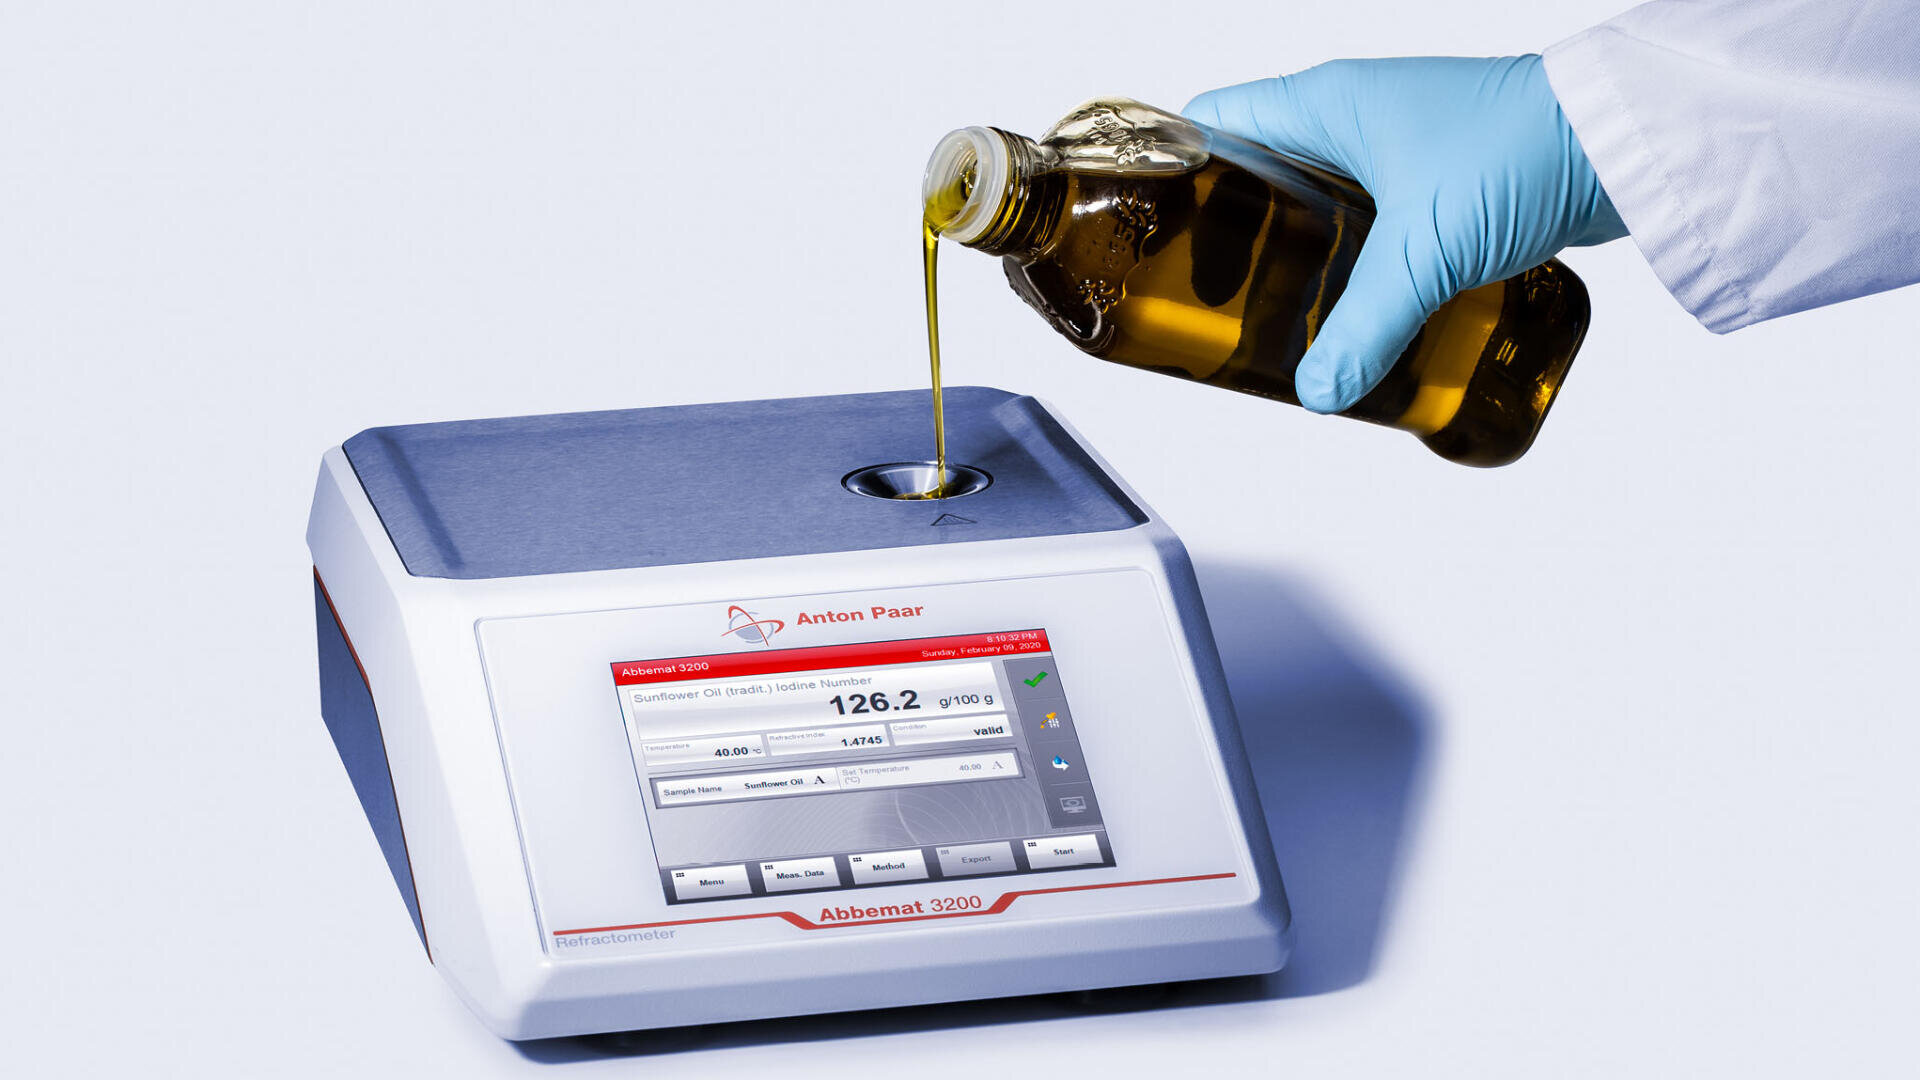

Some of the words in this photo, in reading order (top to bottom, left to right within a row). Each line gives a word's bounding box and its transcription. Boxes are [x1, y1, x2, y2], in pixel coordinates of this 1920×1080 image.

[797, 610, 863, 625] Anton
[871, 605, 924, 618] Paar
[1021, 632, 1038, 640] PM
[921, 649, 959, 658] Sunday,
[960, 645, 1001, 655] February
[1003, 644, 1018, 652] 09,
[1019, 641, 1041, 650] 2020
[621, 664, 676, 676] Abbemat
[678, 662, 710, 672] 3200
[633, 690, 700, 703] Sunflower
[703, 687, 722, 698] Oil
[725, 684, 773, 698] (tradit.)
[776, 681, 816, 693] Iodine
[820, 676, 872, 689] Number
[829, 689, 921, 716] 126.2
[938, 695, 979, 709] g/100
[983, 694, 994, 706] g
[973, 725, 1004, 736] valid
[841, 735, 883, 747] 1.4745
[645, 743, 690, 751] Temperature
[714, 746, 749, 757] 40.00
[842, 768, 857, 777] Set
[859, 765, 910, 776] Temperature
[959, 763, 982, 772] 40.00
[663, 788, 696, 797] Sample
[697, 784, 723, 794] Name
[744, 780, 788, 790] Sunflower
[1053, 847, 1075, 856] Start
[961, 854, 992, 865] Export
[872, 861, 906, 871] Method
[776, 871, 803, 880] Meas.
[804, 870, 825, 878] Data
[699, 878, 725, 887] Menu
[819, 900, 924, 922] Abbemat
[930, 895, 982, 912] 3200
[554, 928, 676, 949] Refractometer
